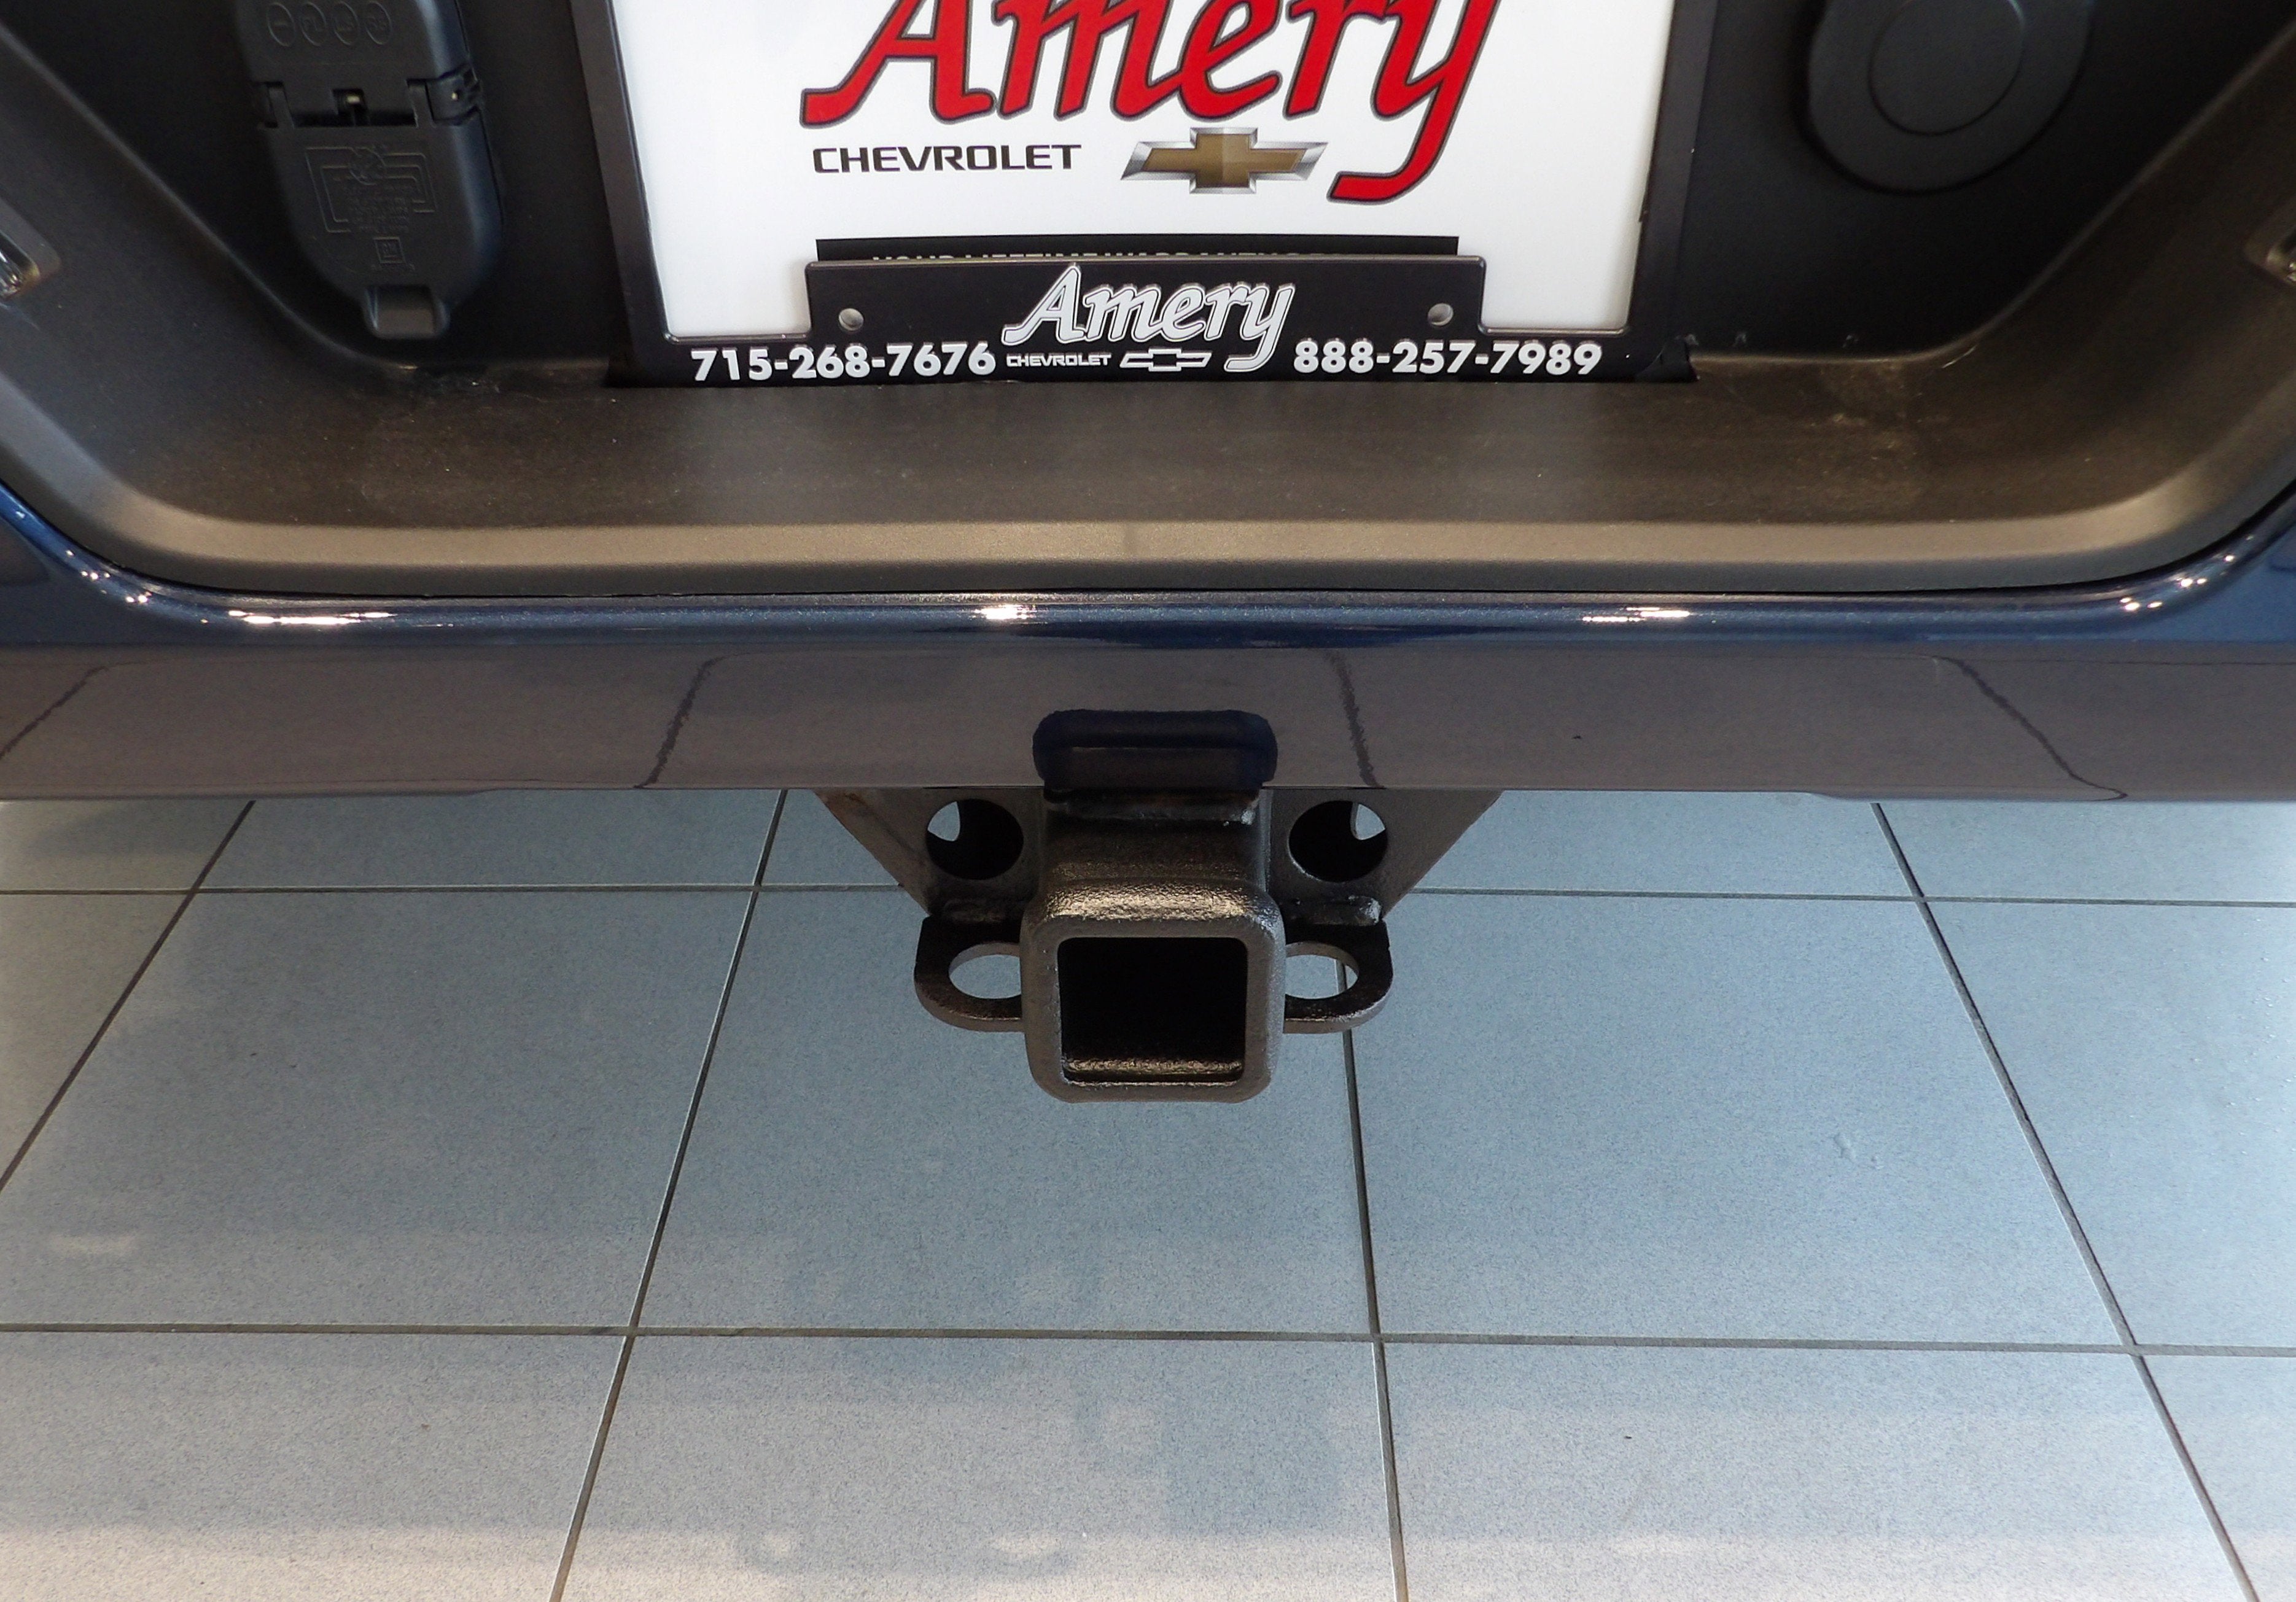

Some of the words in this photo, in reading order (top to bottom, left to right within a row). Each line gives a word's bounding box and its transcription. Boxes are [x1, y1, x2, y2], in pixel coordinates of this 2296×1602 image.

[800, 0, 1501, 204] Amery
[812, 144, 1082, 174] CHEVROLET
[1002, 262, 1296, 372] Amery
[690, 341, 997, 382] 715-268-7676
[1005, 352, 1112, 368] CHEVROLET
[1293, 338, 1603, 375] 888-257-7989
